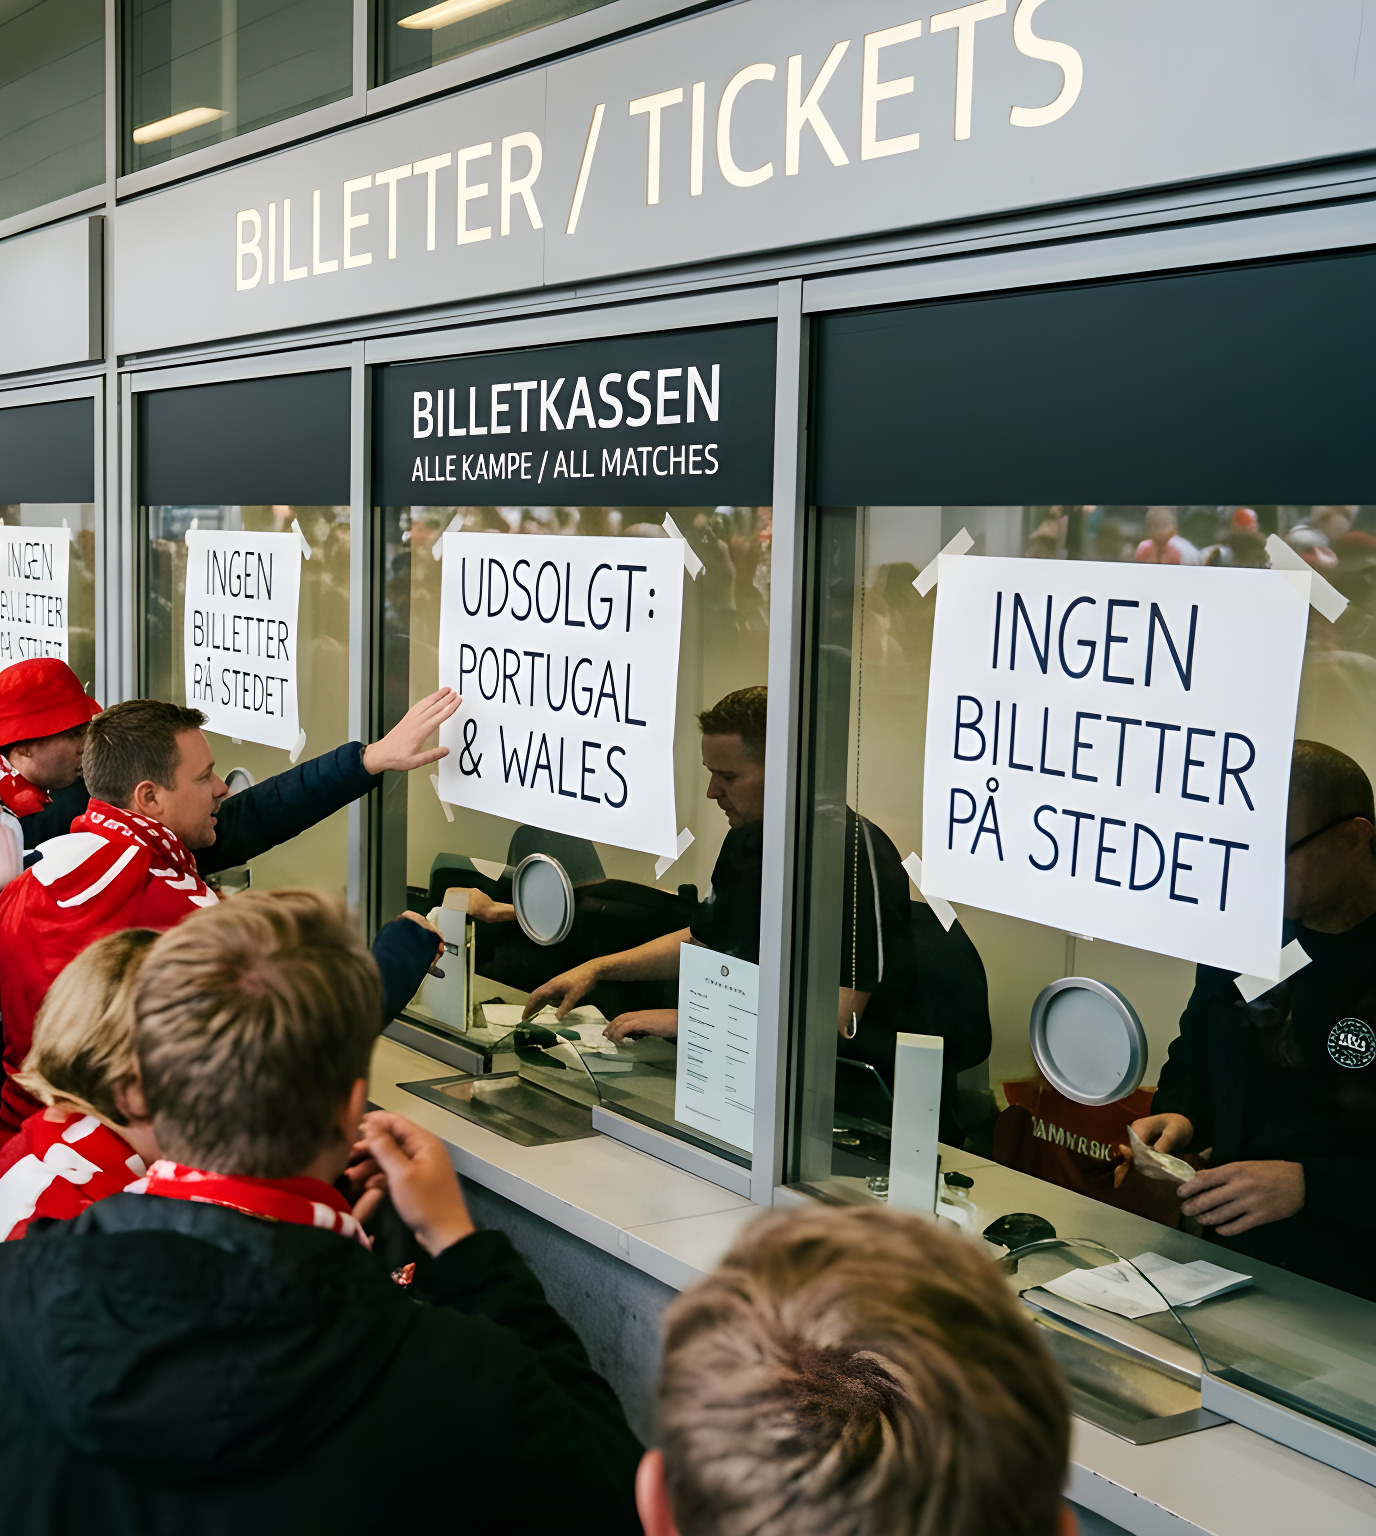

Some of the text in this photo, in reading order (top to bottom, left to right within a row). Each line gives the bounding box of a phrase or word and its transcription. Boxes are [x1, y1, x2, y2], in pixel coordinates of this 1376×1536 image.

[235, 0, 1084, 292] BILLETTER / TICKETS
[413, 363, 721, 439] BILLETKASSEN
[411, 443, 720, 484] ALLE KAMPE / ALL MATCHES
[206, 549, 273, 601] INGEN
[461, 557, 656, 633] UDSOLGT:
[193, 609, 290, 661] BILLETTER
[992, 591, 1199, 692] INGEN
[221, 668, 289, 718] STEDET
[459, 643, 647, 727] PORTUGAL
[458, 717, 629, 809] & WALES
[953, 694, 1257, 812] BILLETTER
[948, 776, 1250, 912] PÅ STEDET
